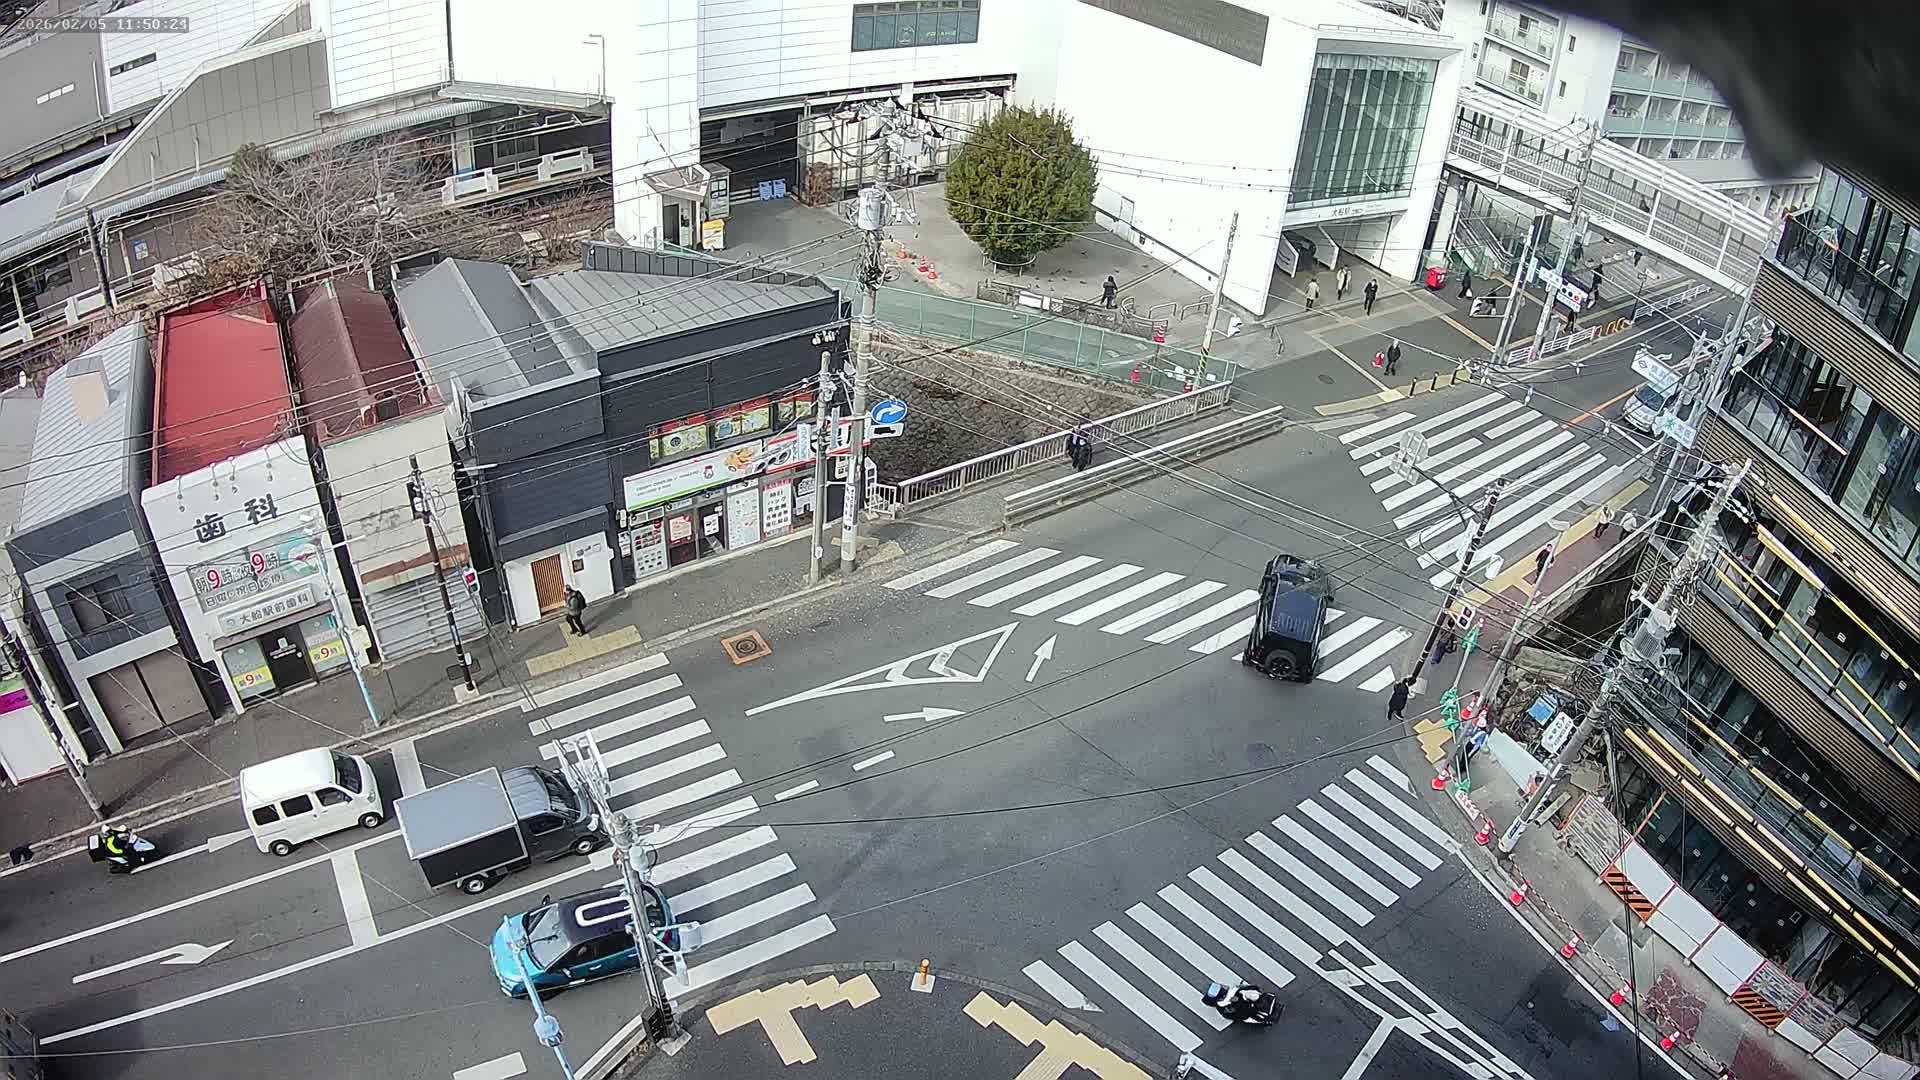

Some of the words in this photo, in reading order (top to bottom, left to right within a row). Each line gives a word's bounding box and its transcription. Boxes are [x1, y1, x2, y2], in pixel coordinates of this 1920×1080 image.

[193, 492, 279, 543] 歯科
[239, 593, 309, 626] 大船駅前歯科
